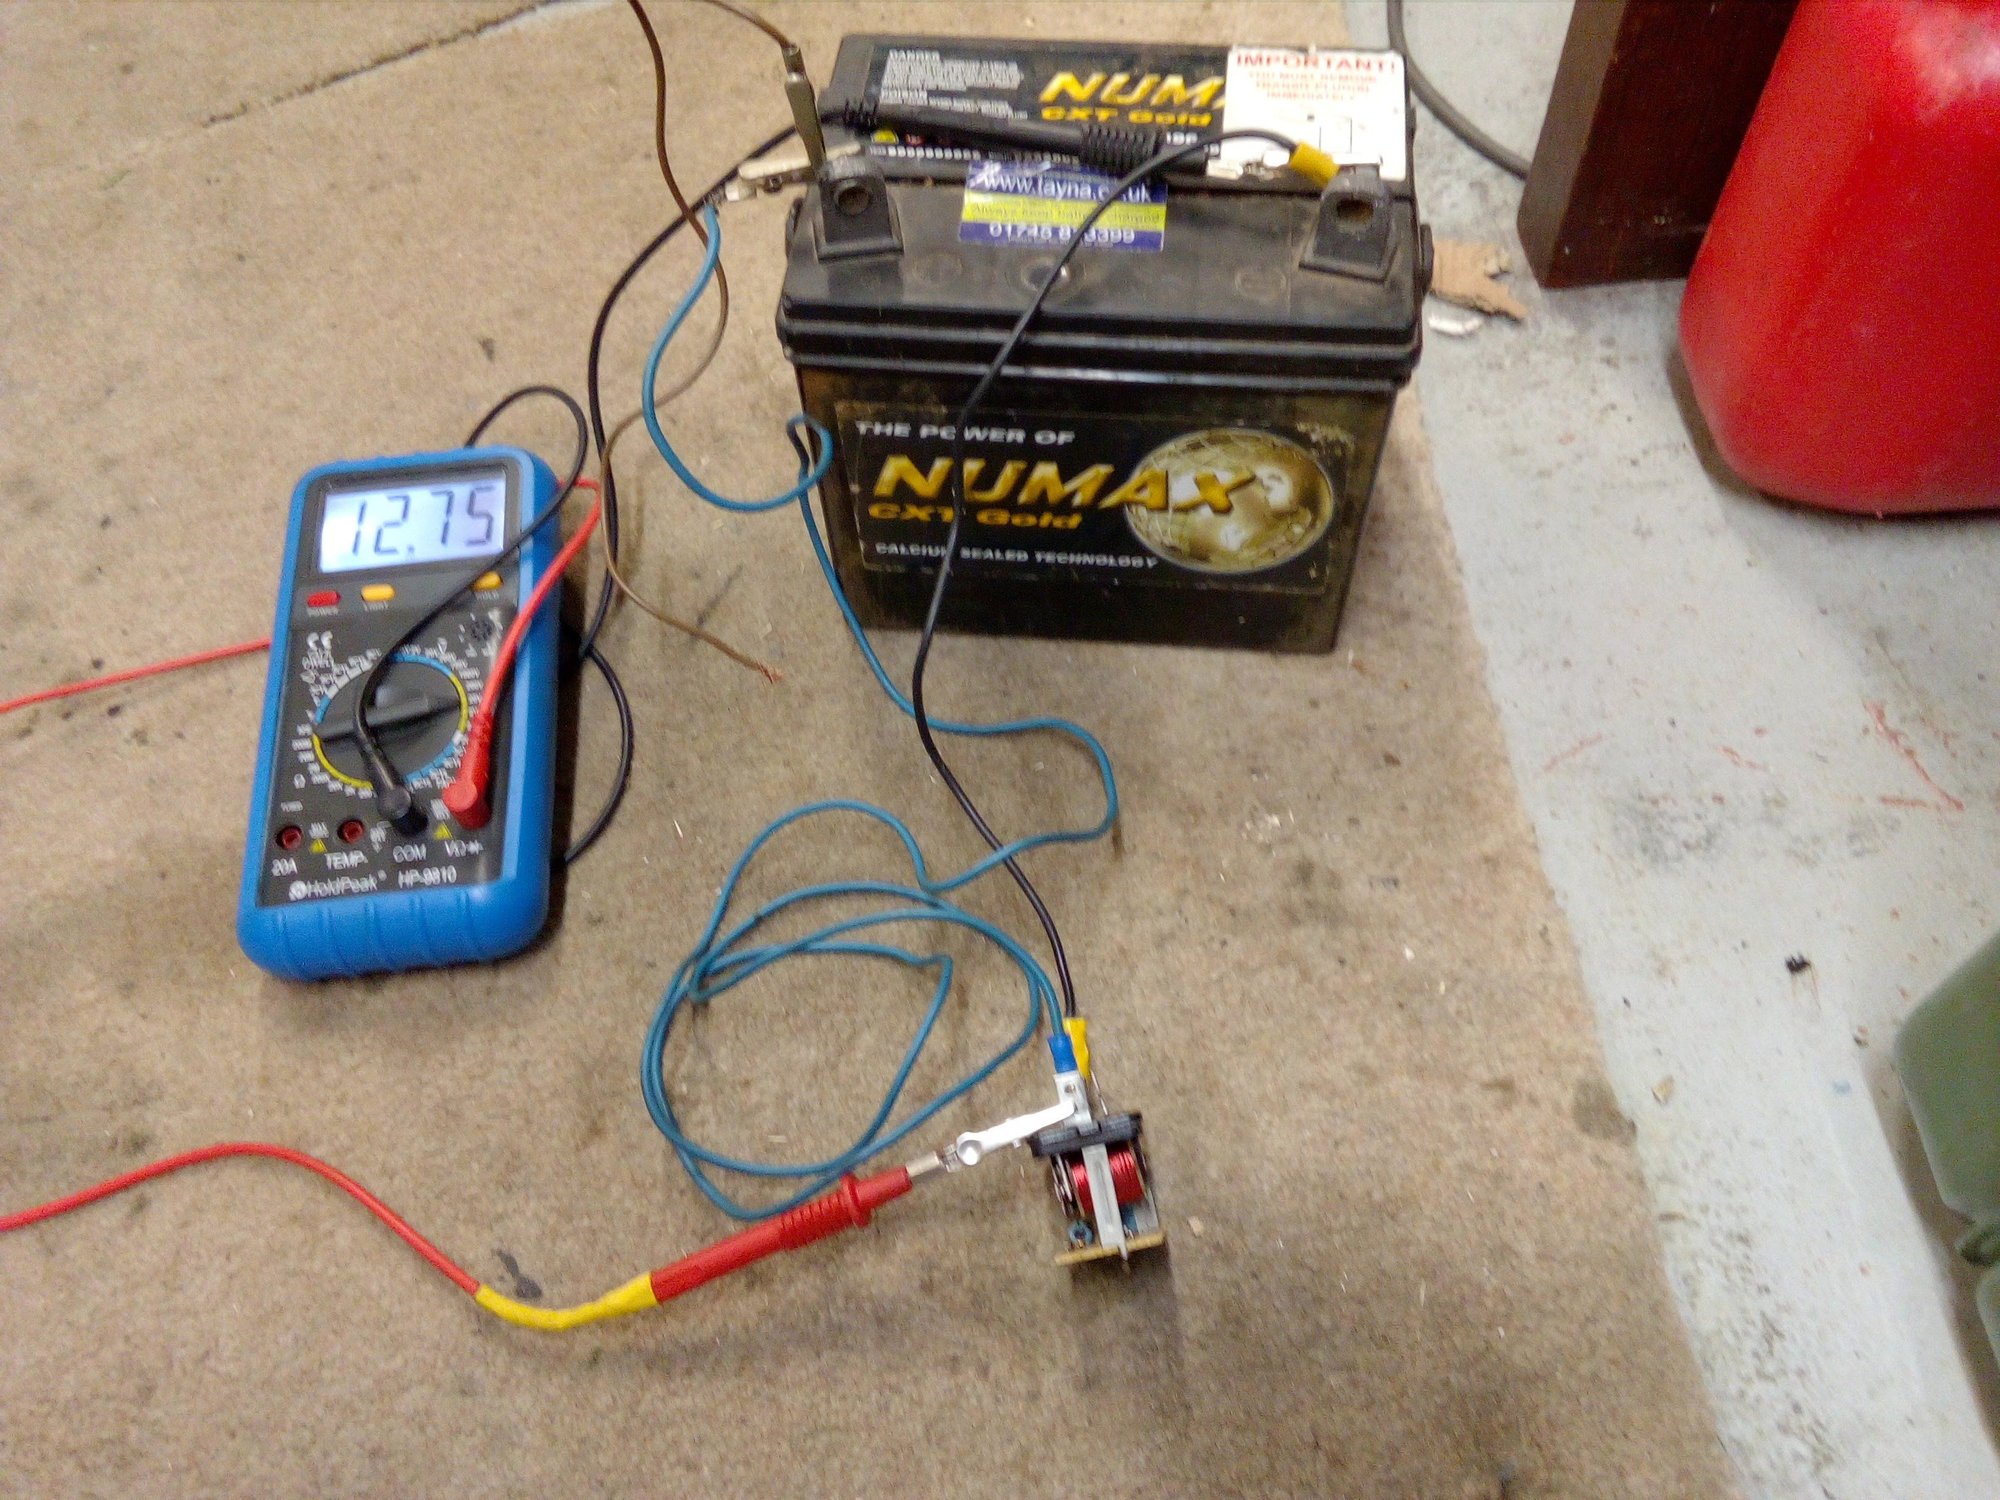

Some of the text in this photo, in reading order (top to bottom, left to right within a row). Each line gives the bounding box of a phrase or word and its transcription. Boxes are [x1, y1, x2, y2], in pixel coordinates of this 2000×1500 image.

[983, 173, 1151, 204] www.tayna.c.uk
[856, 420, 912, 438] THE
[1034, 429, 1076, 446] OF
[872, 453, 1258, 515] NUMAX
[352, 484, 496, 556] 12.75
[975, 508, 1083, 530] Gold
[960, 546, 1029, 562] SEALED
[1035, 550, 1158, 569] TECHNOLOGY
